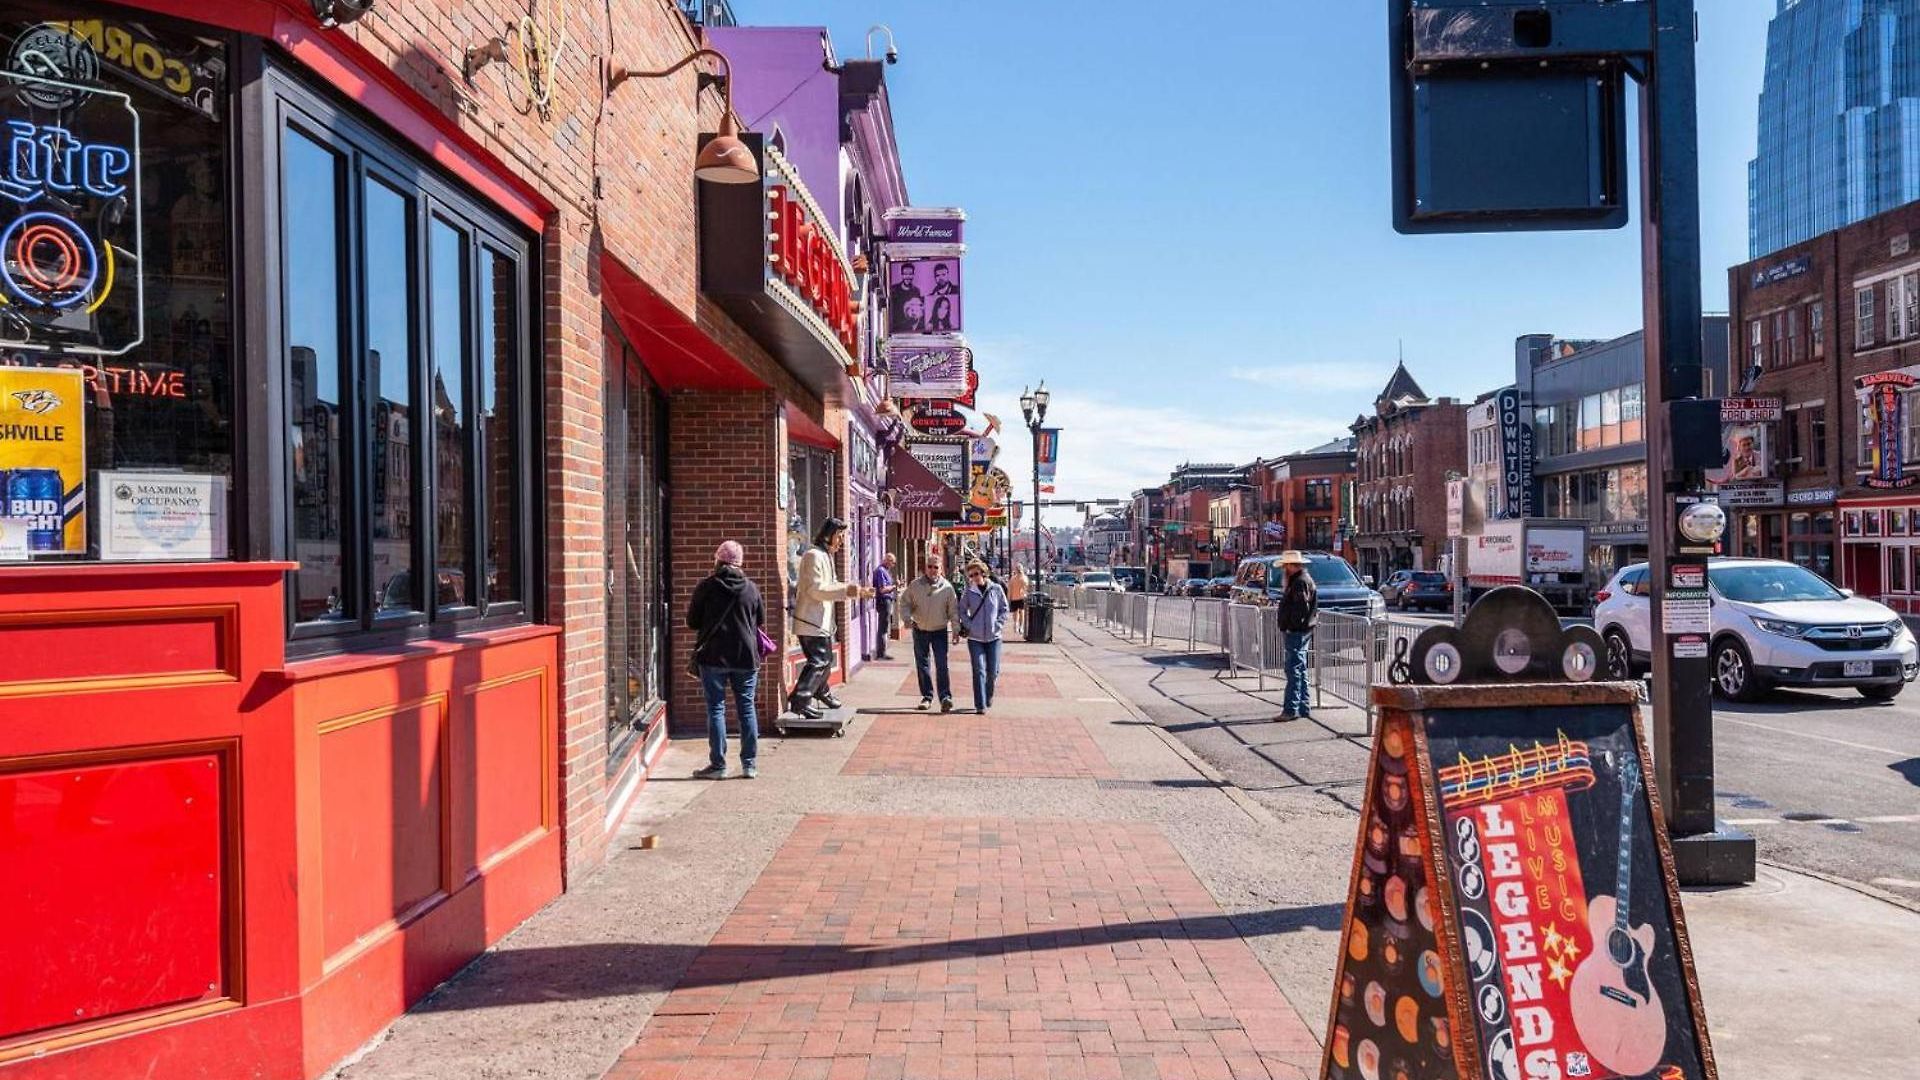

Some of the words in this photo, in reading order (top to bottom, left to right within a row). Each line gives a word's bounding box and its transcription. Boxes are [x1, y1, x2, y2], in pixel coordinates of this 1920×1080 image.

[897, 225, 921, 237] World
[920, 225, 953, 238] Famous
[1861, 373, 1915, 387] NASHVILLE
[1750, 410, 1775, 420] SHOP
[1503, 396, 1519, 513] DOWNTOWN
[1522, 432, 1532, 487] SPORTING
[138, 485, 197, 495] MAXIMUM
[896, 483, 945, 499] Second
[1815, 489, 1834, 500] SHOP
[11, 499, 58, 515] BUD
[131, 496, 201, 507] OCCUPANCY
[899, 496, 945, 508] Fiddle
[1519, 801, 1552, 911] LIVE
[1536, 796, 1577, 922] MUSIC
[1479, 804, 1563, 1080] LEGENDS
